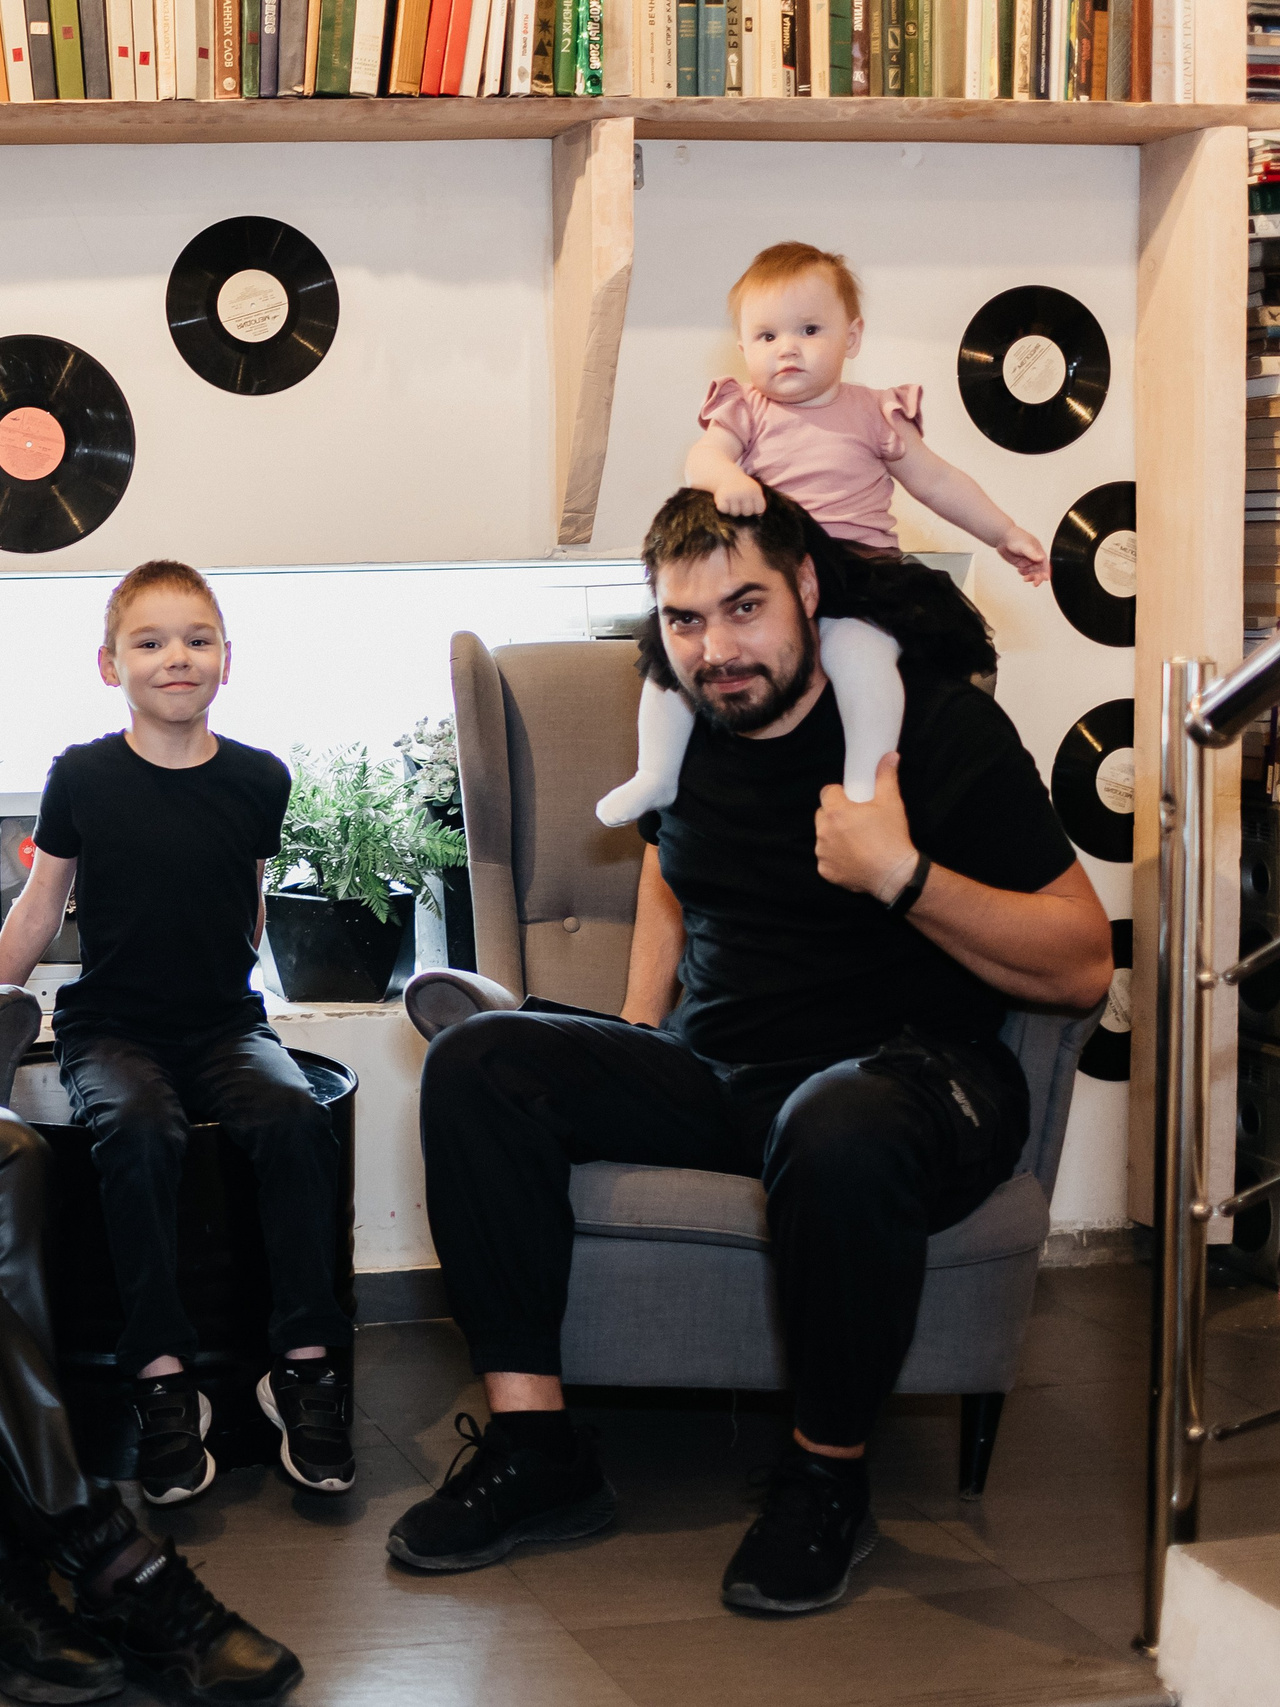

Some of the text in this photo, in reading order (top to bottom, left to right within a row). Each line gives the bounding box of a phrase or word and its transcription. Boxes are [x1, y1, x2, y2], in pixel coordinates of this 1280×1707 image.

[560, 38, 572, 53] 2
[588, 0, 601, 70] КОРДЫ 2006
[223, 38, 233, 68] СЛОВ
[236, 315, 270, 330] МЕЛОДИЯ
